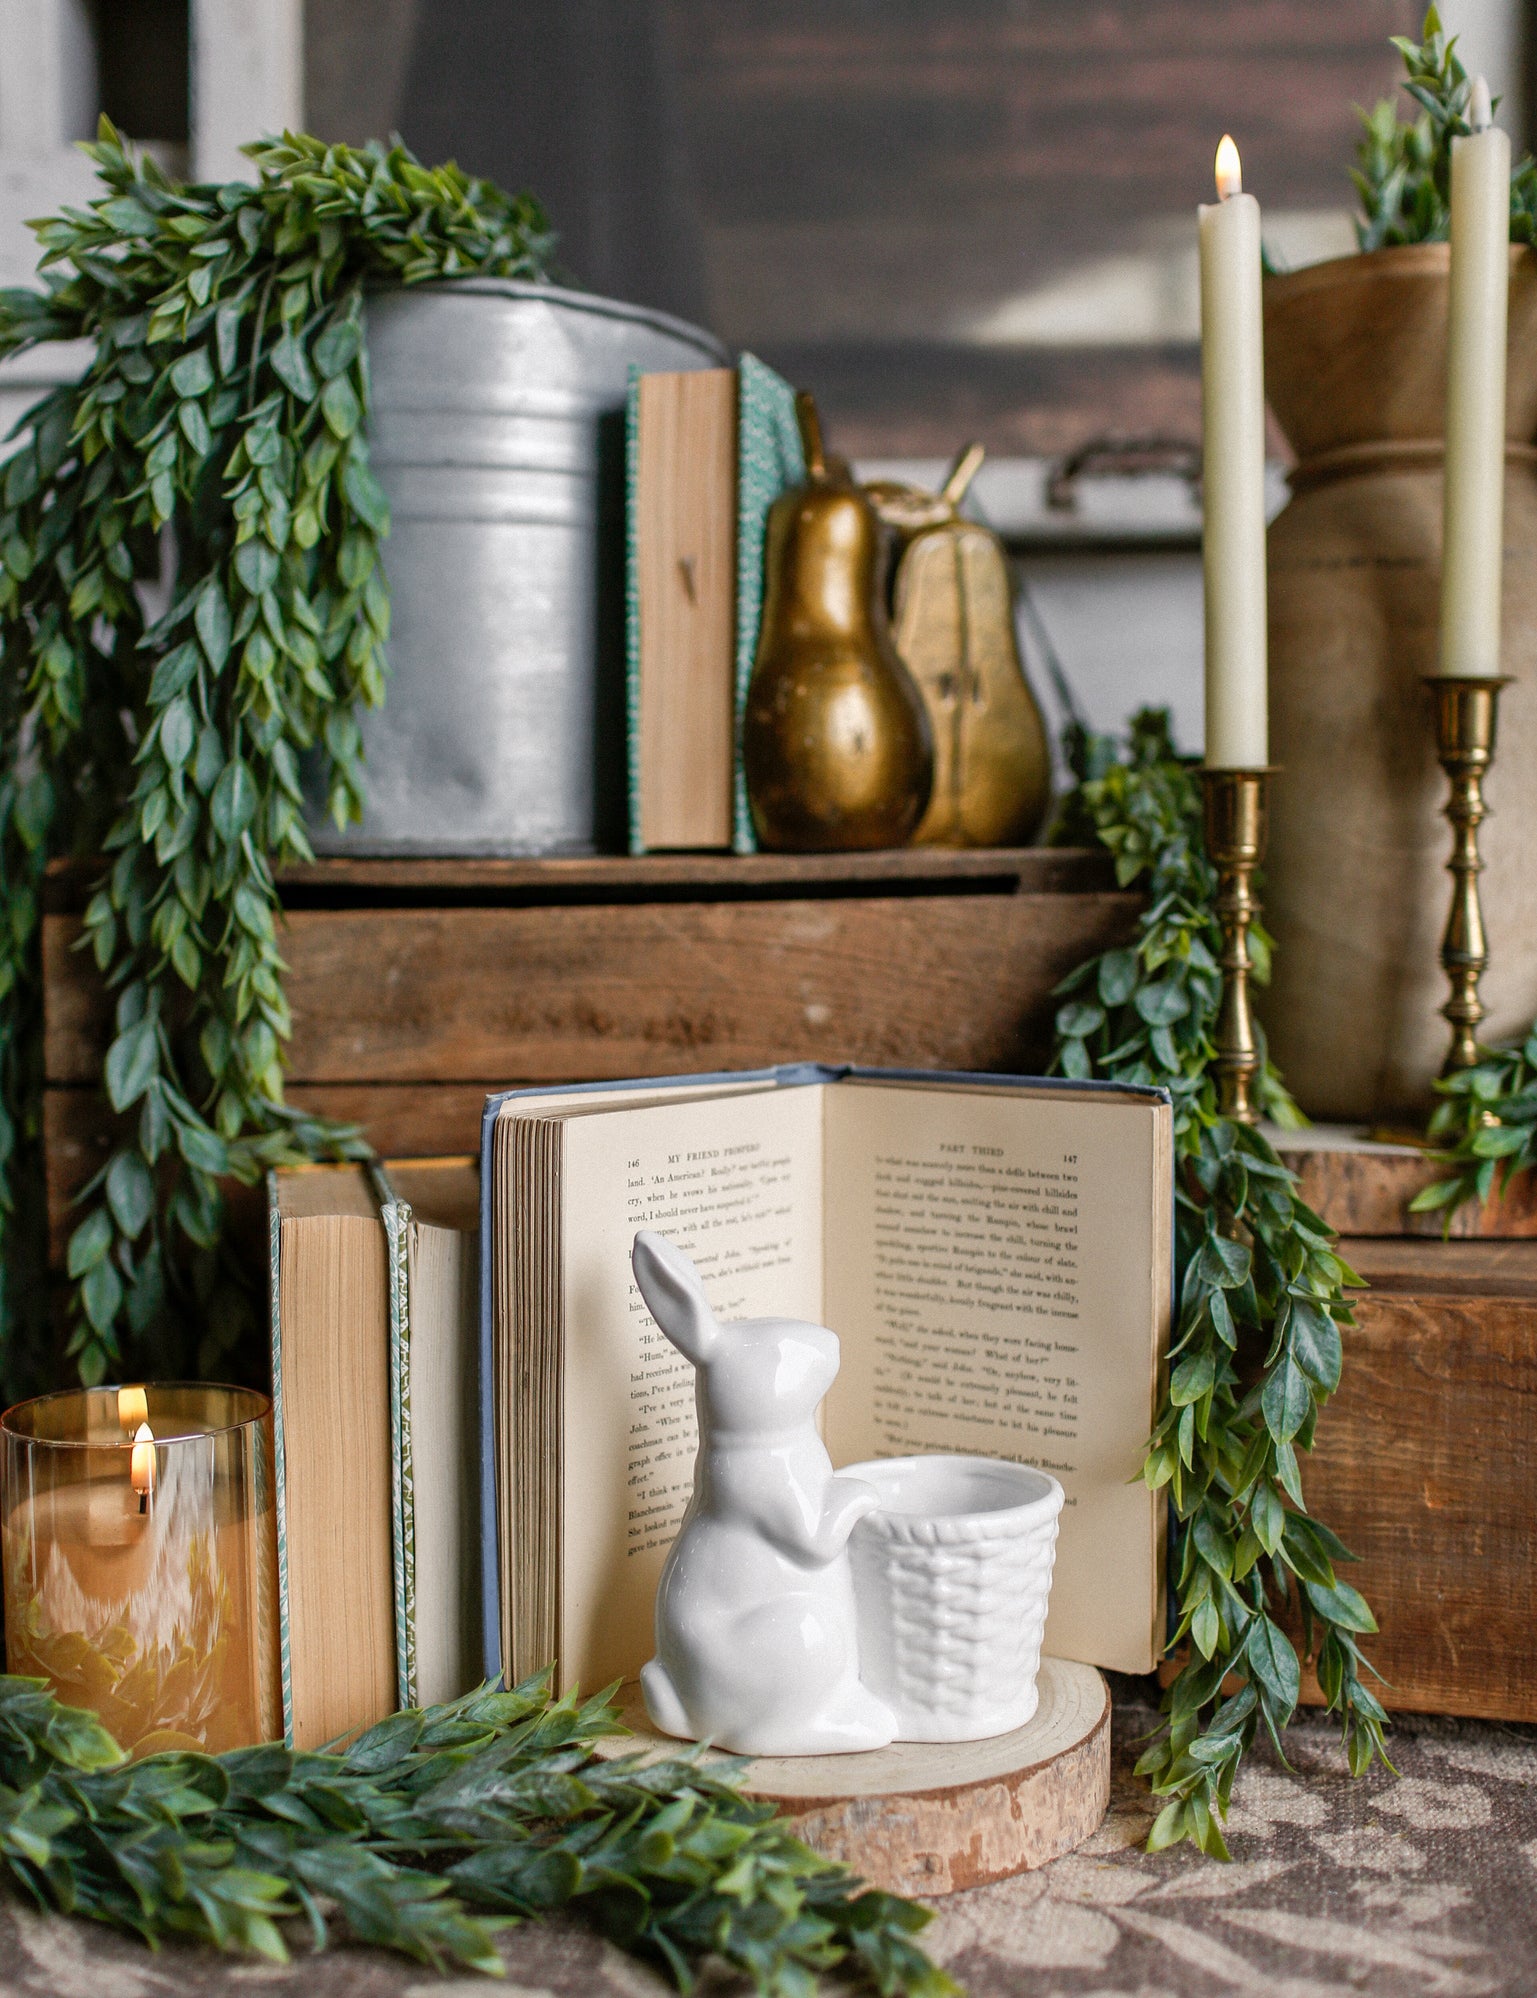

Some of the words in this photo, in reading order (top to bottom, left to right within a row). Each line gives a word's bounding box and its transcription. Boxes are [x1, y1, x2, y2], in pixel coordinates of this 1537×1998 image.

[628, 1159, 640, 1168] 146
[668, 1155, 680, 1164] MY
[687, 1151, 719, 1161] FRIEND
[972, 1146, 1004, 1157] THIRD
[1064, 1155, 1078, 1164] 147
[978, 1163, 995, 1173] than
[1028, 1168, 1060, 1181] between
[1062, 1173, 1078, 1182] two
[628, 1177, 645, 1187] land.
[627, 1198, 642, 1207] cry,
[647, 1193, 665, 1202] when
[670, 1190, 678, 1199] he
[1045, 1187, 1078, 1199] hillsides
[628, 1212, 648, 1222] word,
[655, 1208, 679, 1219] should
[680, 1207, 698, 1215] never
[700, 1204, 715, 1212] have
[992, 1199, 1005, 1208] the
[1008, 1202, 1020, 1210] air
[1022, 1203, 1039, 1212] with
[1041, 1204, 1059, 1215] chill
[1062, 1208, 1078, 1217] and
[683, 1223, 697, 1231] with
[701, 1220, 709, 1229] all
[1054, 1222, 1078, 1235] brawl
[989, 1232, 1002, 1242] the
[1030, 1238, 1062, 1251] turning
[1065, 1241, 1078, 1251] the
[1000, 1250, 1012, 1260] the
[1044, 1256, 1053, 1265] of
[1046, 1274, 1064, 1283] with
[1006, 1286, 1019, 1295] the
[1022, 1287, 1034, 1297] air
[1036, 1291, 1051, 1299] was
[1053, 1291, 1079, 1305] chilly,
[1015, 1304, 1033, 1313] with
[1035, 1306, 1049, 1316] the
[981, 1333, 999, 1346] they
[1024, 1338, 1053, 1352] facing
[984, 1350, 1008, 1361] What
[1012, 1353, 1021, 1362] of
[631, 1371, 643, 1382] had
[646, 1365, 672, 1378] received
[1043, 1376, 1061, 1387] very
[631, 1390, 649, 1399] tions,
[652, 1386, 664, 1395] I've
[1047, 1391, 1057, 1400] he
[1063, 1394, 1078, 1403] felt
[670, 1399, 684, 1408] very
[1016, 1404, 1029, 1413] the
[1034, 1409, 1054, 1417] same
[1059, 1411, 1078, 1421] time
[1043, 1426, 1078, 1438] pleasure
[629, 1438, 663, 1451] coachman
[628, 1456, 651, 1471] graph
[637, 1491, 645, 1500] "I
[650, 1486, 668, 1498] think
[628, 1528, 641, 1537] She
[644, 1520, 667, 1533] looked
[628, 1545, 645, 1557] gave
[647, 1540, 657, 1549] the
